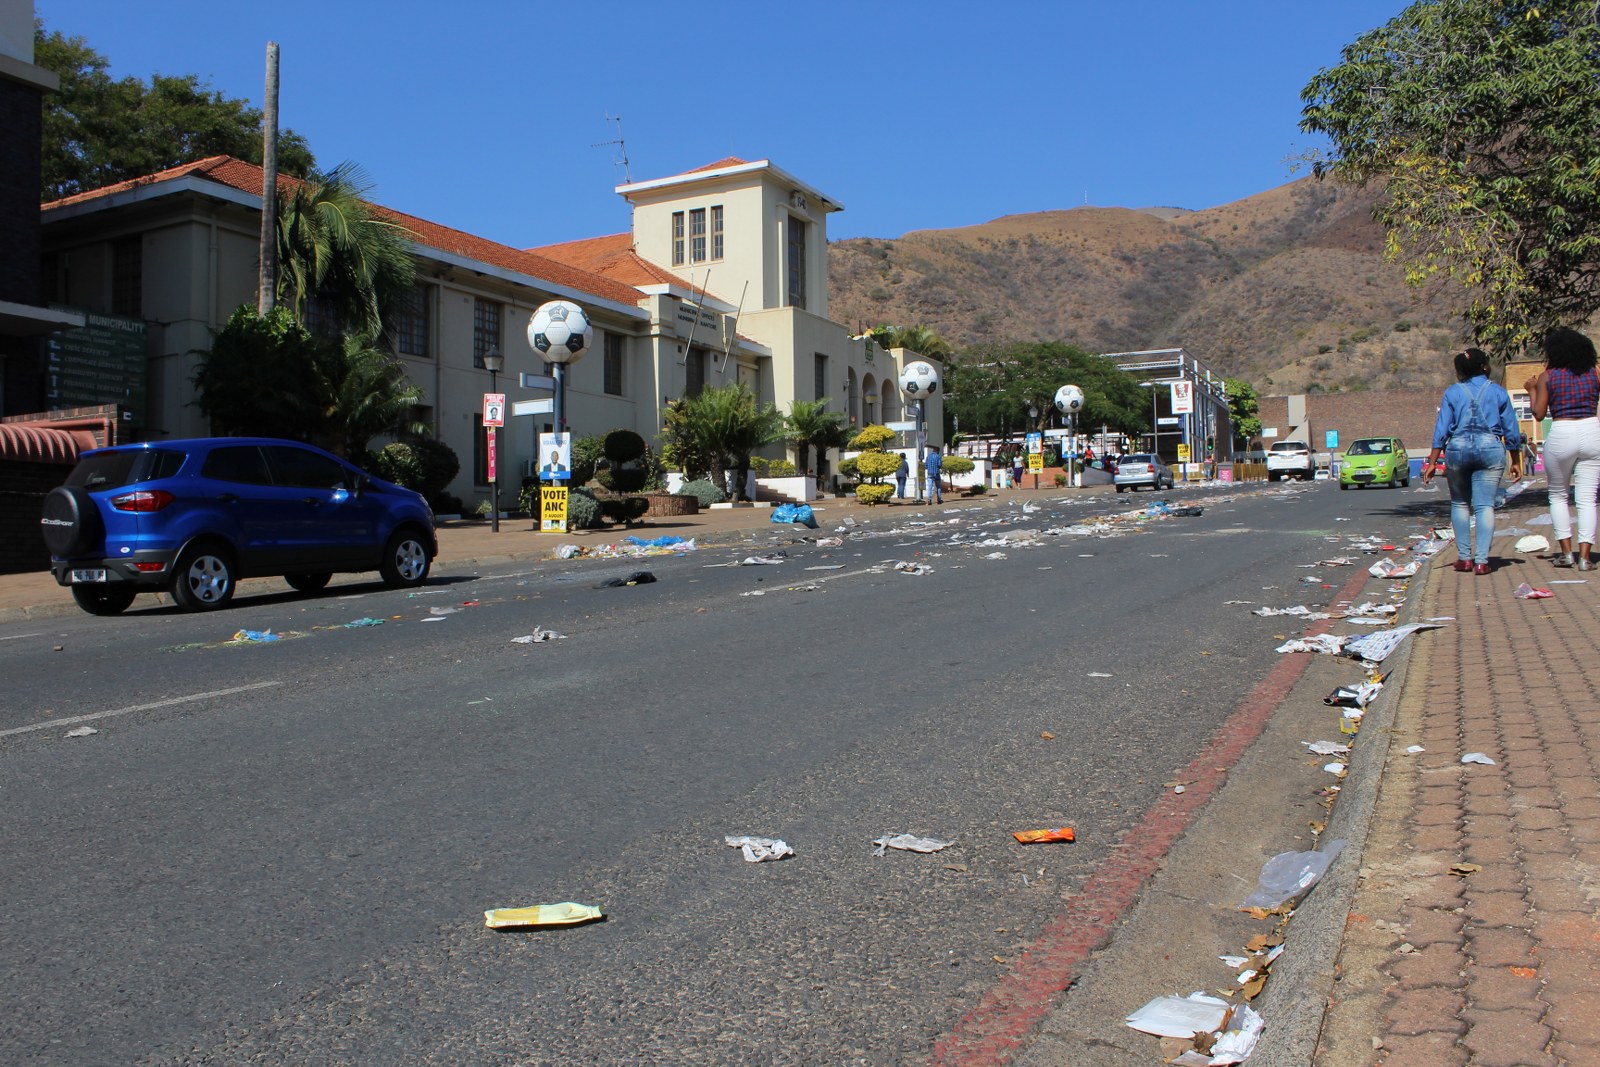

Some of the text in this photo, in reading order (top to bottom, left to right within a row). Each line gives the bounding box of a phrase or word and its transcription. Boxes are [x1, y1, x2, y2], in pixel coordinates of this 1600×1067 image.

[89, 314, 144, 333] MUNICIPALITY
[543, 490, 566, 500] VOTE
[544, 501, 564, 511] ANC
